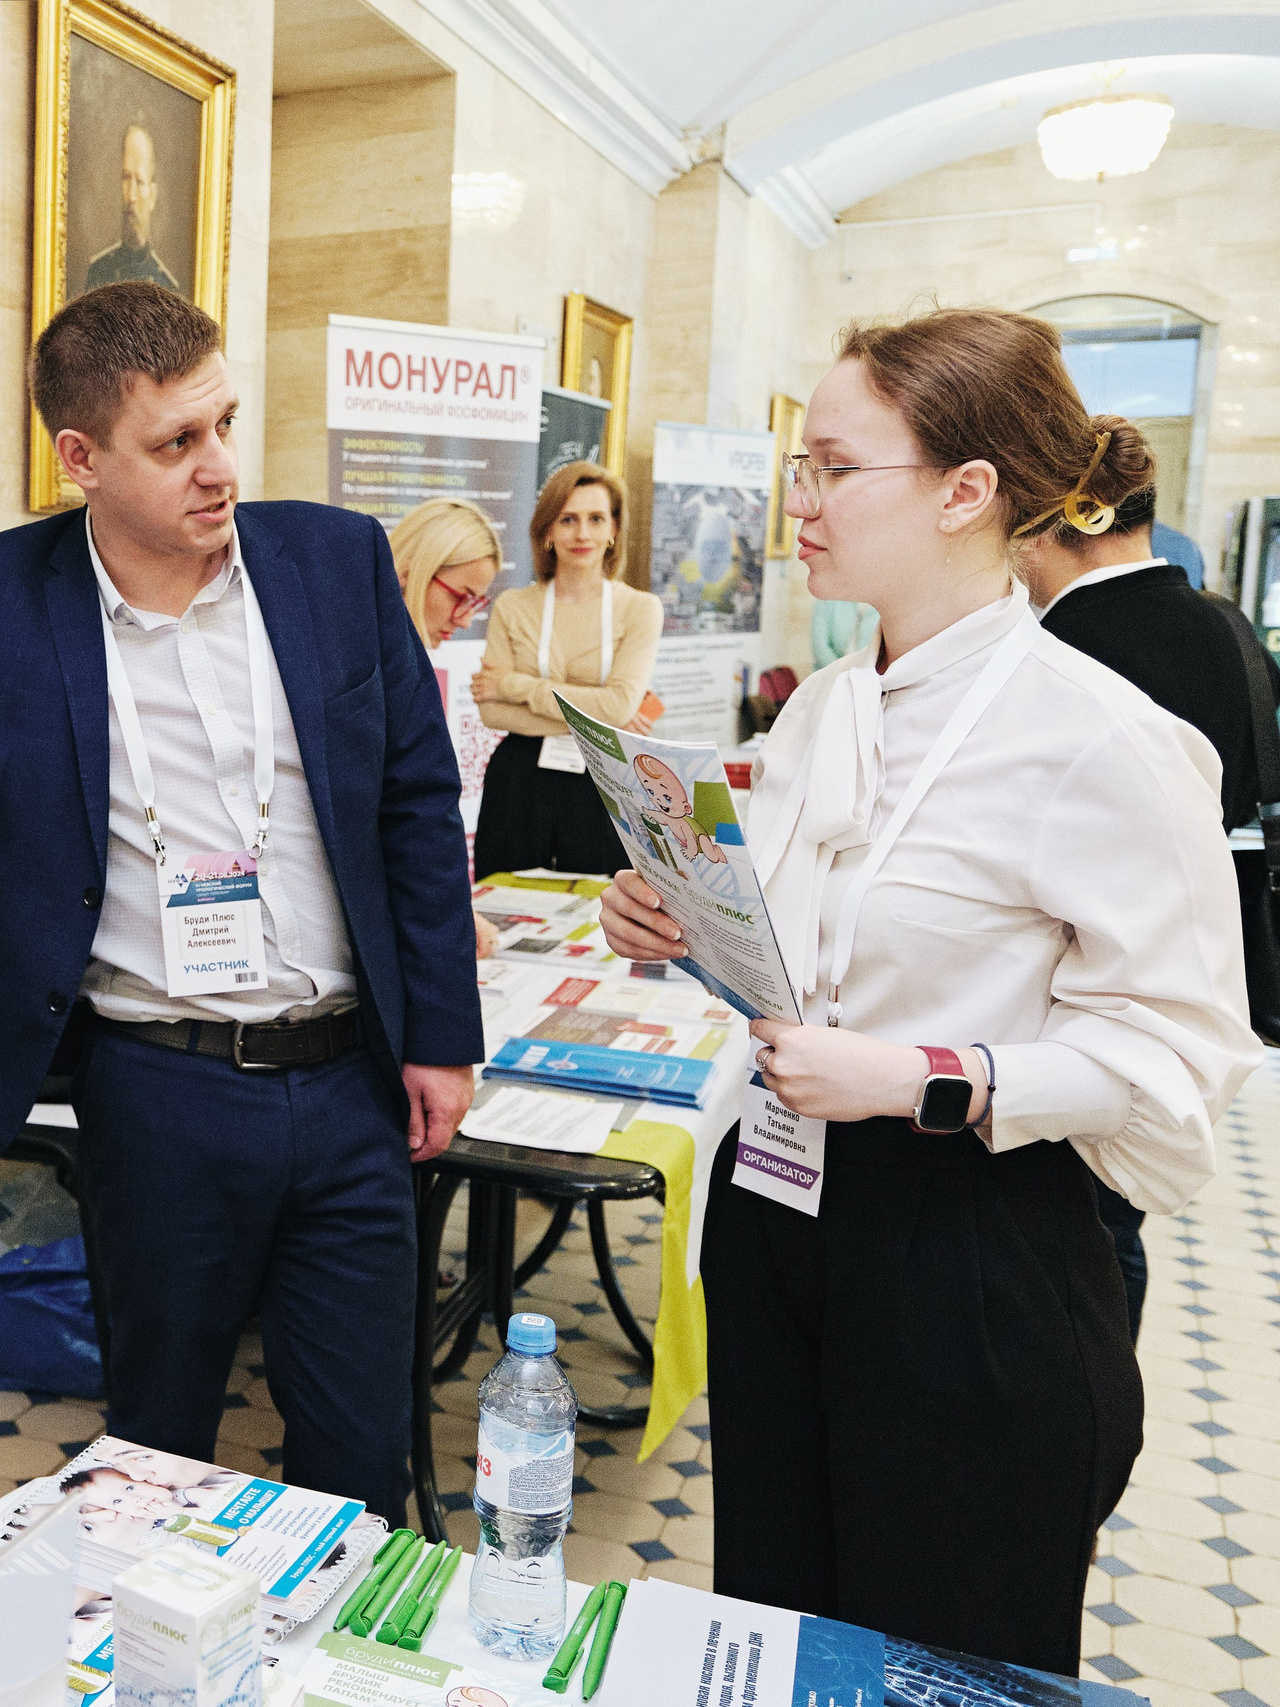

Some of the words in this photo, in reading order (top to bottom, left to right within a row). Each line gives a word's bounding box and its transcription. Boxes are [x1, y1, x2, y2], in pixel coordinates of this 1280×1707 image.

[183, 915, 211, 926] Бруди
[211, 913, 236, 923] Плюс
[192, 925, 230, 937] Дмитрий
[187, 937, 237, 949] Алексеевич
[183, 958, 251, 974] УЧАСТНИК
[764, 1100, 801, 1123] Марченко
[766, 1115, 796, 1136] Татьяна
[753, 1123, 807, 1155] Владимировна
[743, 1150, 815, 1187] ОРГАНИЗАТОР
[222, 1487, 262, 1521] МЕЧТАЕТЕ
[247, 1490, 278, 1520] МАЛЫШЕ?
[331, 1670, 383, 1690] БРУДИК
[335, 1662, 390, 1683] МАЛЫШ
[327, 1677, 422, 1707] РЕКОМЕНДУЕТ
